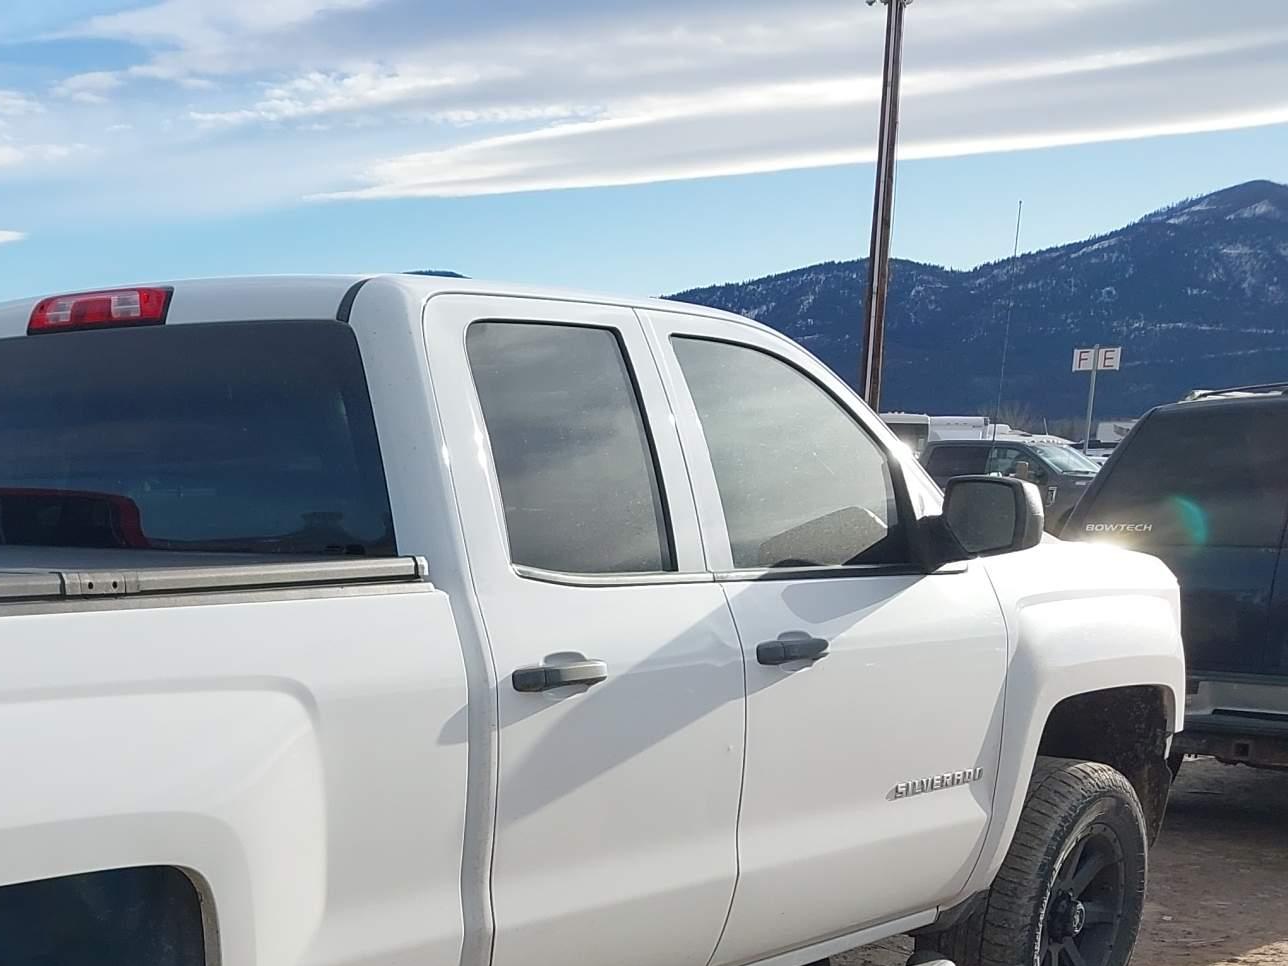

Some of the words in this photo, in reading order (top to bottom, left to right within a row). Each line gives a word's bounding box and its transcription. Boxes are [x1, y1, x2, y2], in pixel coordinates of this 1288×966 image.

[1078, 350, 1091, 369] F
[1102, 349, 1116, 368] E
[1085, 523, 1153, 532] BOWTECH
